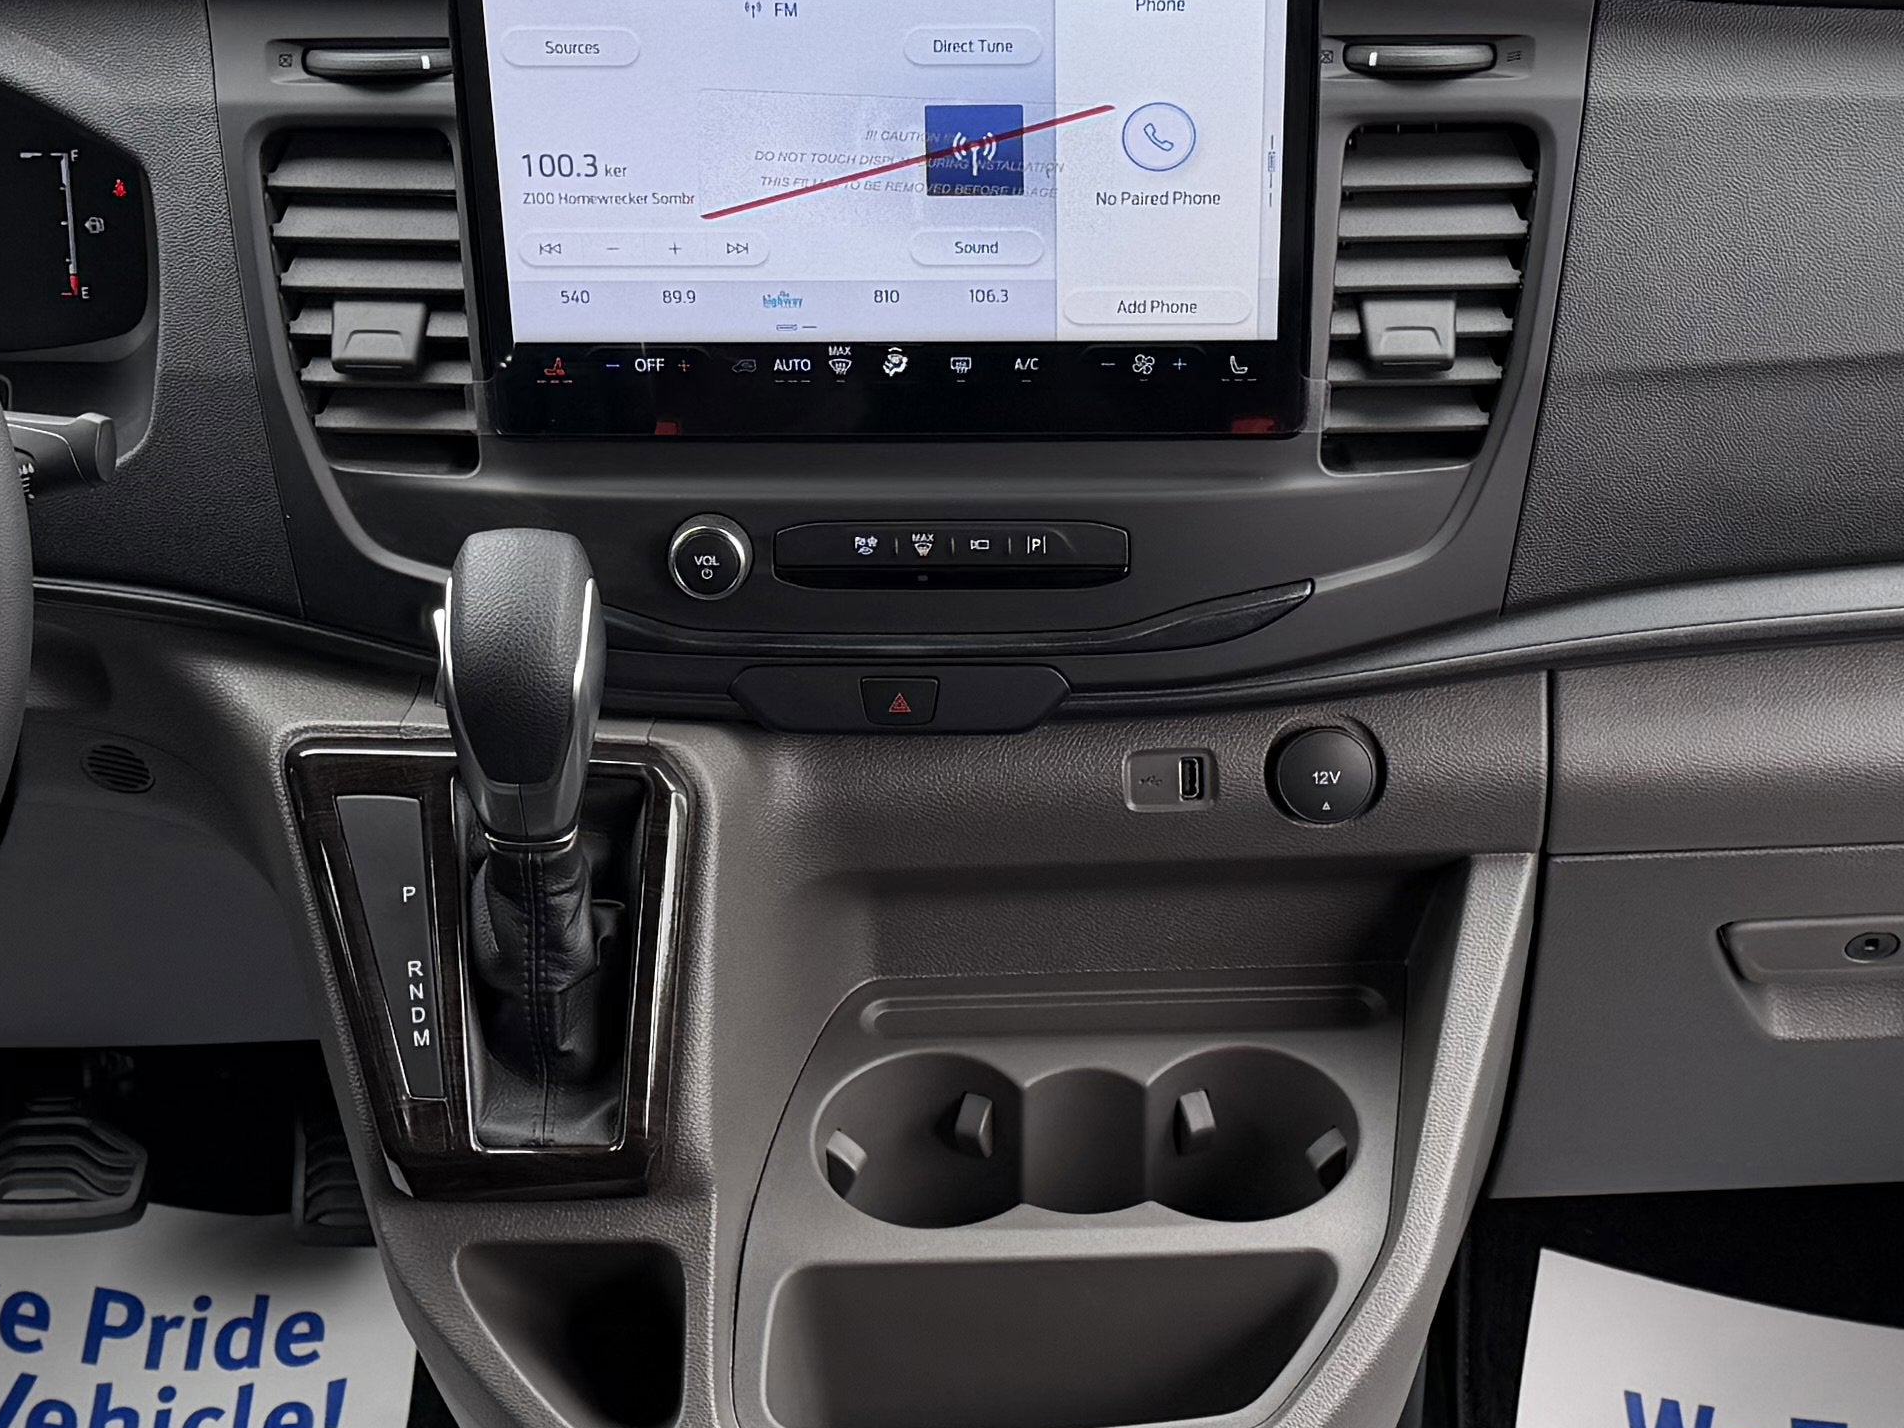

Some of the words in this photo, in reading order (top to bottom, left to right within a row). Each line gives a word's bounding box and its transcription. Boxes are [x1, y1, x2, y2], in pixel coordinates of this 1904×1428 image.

[775, 2, 799, 18] FM
[545, 40, 601, 55] Sources
[933, 39, 974, 53] Direct
[978, 39, 1014, 53] Tune
[754, 150, 775, 163] DO
[778, 150, 807, 164] NOT
[811, 152, 857, 165] TOUCH
[522, 153, 598, 178] 100.3
[760, 175, 790, 188] THIS
[863, 181, 882, 192] BE
[523, 192, 555, 205] Z100
[558, 191, 649, 205] Homewrecker
[652, 191, 696, 205] Sombr
[1095, 191, 1118, 206] No
[1120, 190, 1170, 206] Paired
[1172, 190, 1221, 206] Phone
[954, 240, 1000, 255] Sound
[560, 289, 591, 305] 540
[662, 289, 697, 305] 89.9
[874, 288, 901, 304] 810
[968, 288, 1010, 304] 106.3
[1116, 300, 1148, 314] Add
[1150, 300, 1198, 314] Phone
[828, 345, 851, 355] MAX
[634, 357, 665, 372] OFF
[773, 357, 811, 372] AUTO
[1014, 357, 1039, 372] A/C
[693, 555, 720, 568] VOL
[1311, 770, 1342, 785] 12V
[402, 886, 416, 903] P
[80, 1284, 326, 1372] Pride
